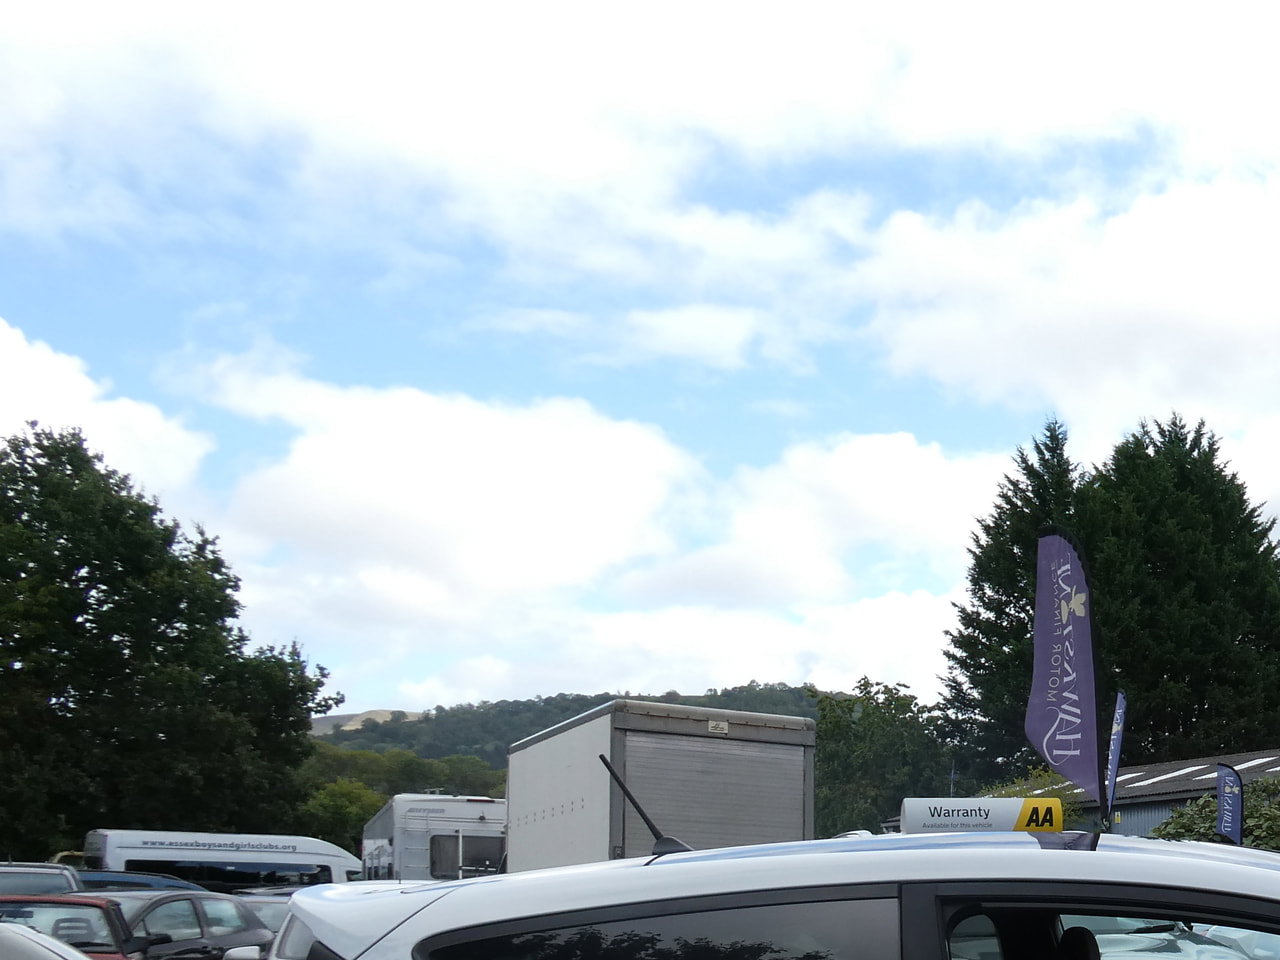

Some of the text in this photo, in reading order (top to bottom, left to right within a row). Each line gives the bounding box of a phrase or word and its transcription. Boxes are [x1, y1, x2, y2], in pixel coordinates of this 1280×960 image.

[928, 806, 991, 820] Warranty
[1025, 806, 1054, 828] AA
[141, 839, 297, 851] www.essexboysandgirlsclubs.org
